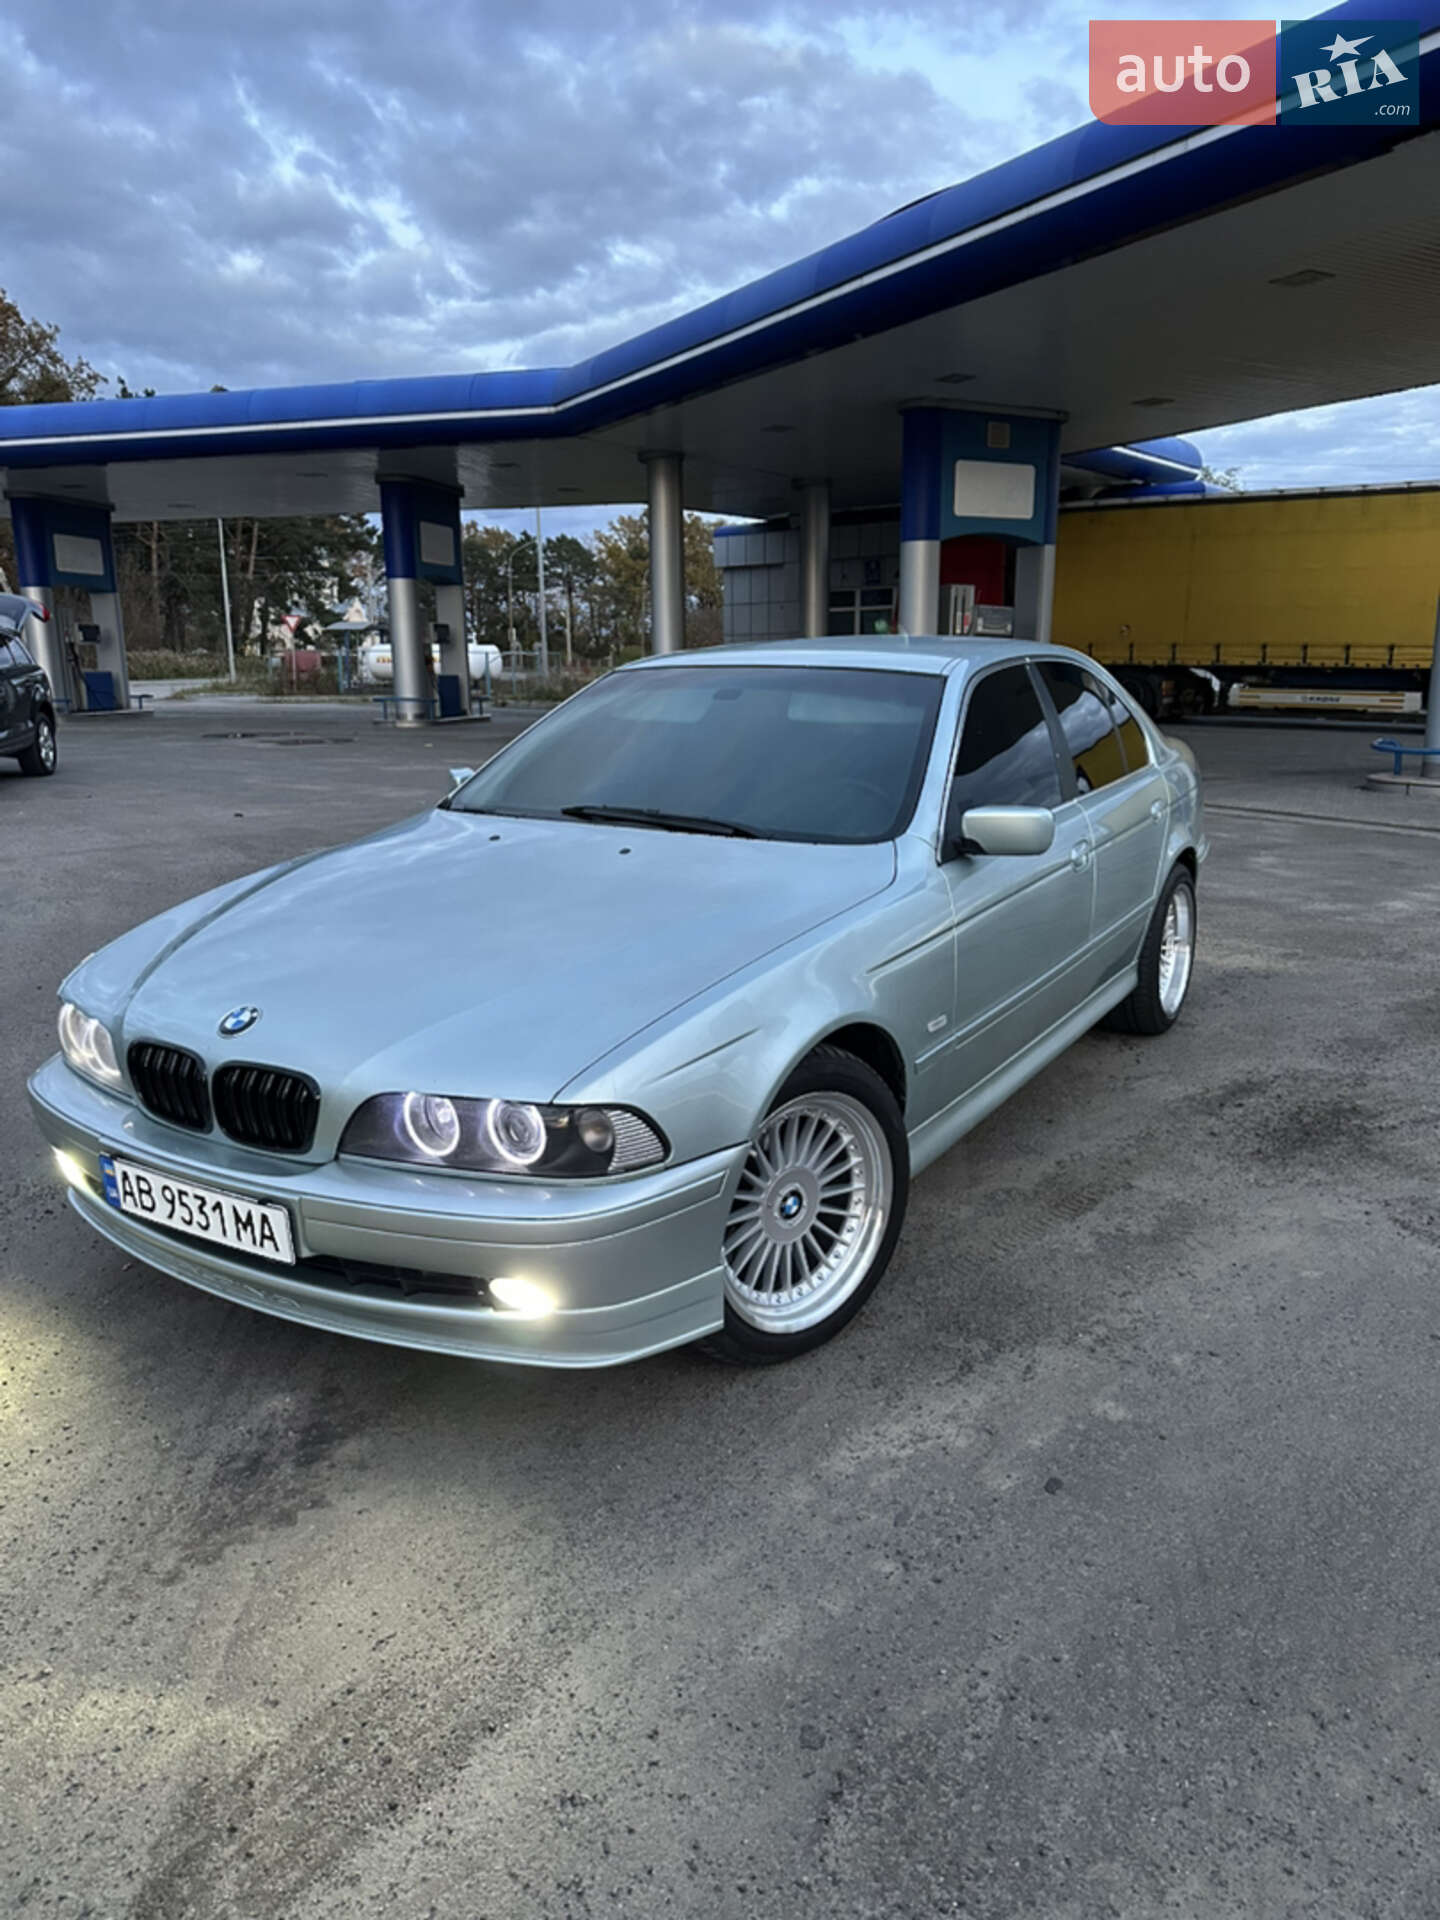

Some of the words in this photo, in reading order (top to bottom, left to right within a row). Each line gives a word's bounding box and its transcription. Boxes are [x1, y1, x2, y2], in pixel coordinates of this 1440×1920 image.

[121, 1170, 156, 1213] AB
[161, 1185, 227, 1238] 9531
[232, 1204, 279, 1252] MA
